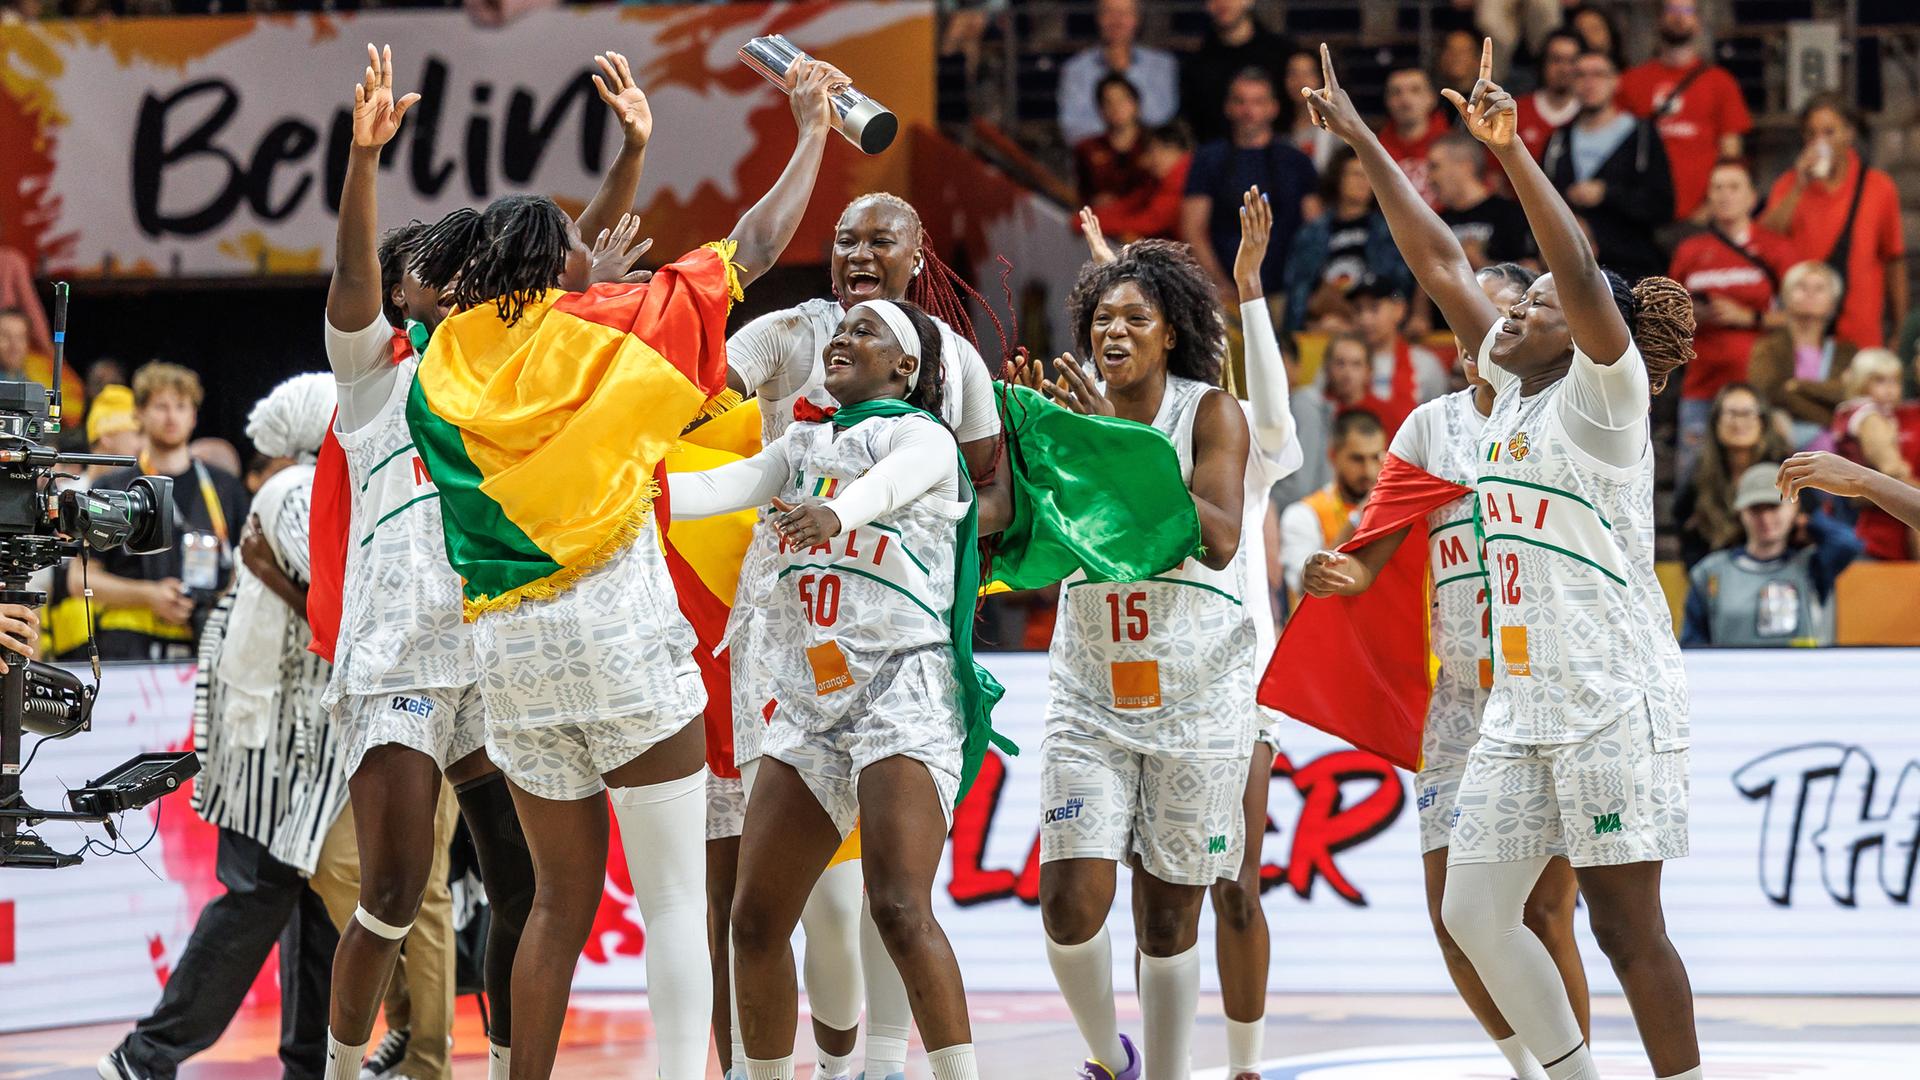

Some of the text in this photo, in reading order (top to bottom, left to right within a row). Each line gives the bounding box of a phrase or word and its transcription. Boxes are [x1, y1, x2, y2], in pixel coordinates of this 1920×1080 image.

[10, 472, 33, 480] SONY
[1483, 493, 1550, 530] ALI
[93, 529, 110, 539] Canon
[1497, 553, 1522, 605] 12
[798, 574, 841, 627] 50
[1106, 591, 1149, 643] 15
[817, 673, 848, 692] orange
[1116, 694, 1156, 706] orange
[1066, 797, 1085, 806] MALI
[1593, 812, 1622, 835] WA
[1208, 834, 1227, 854] WA
